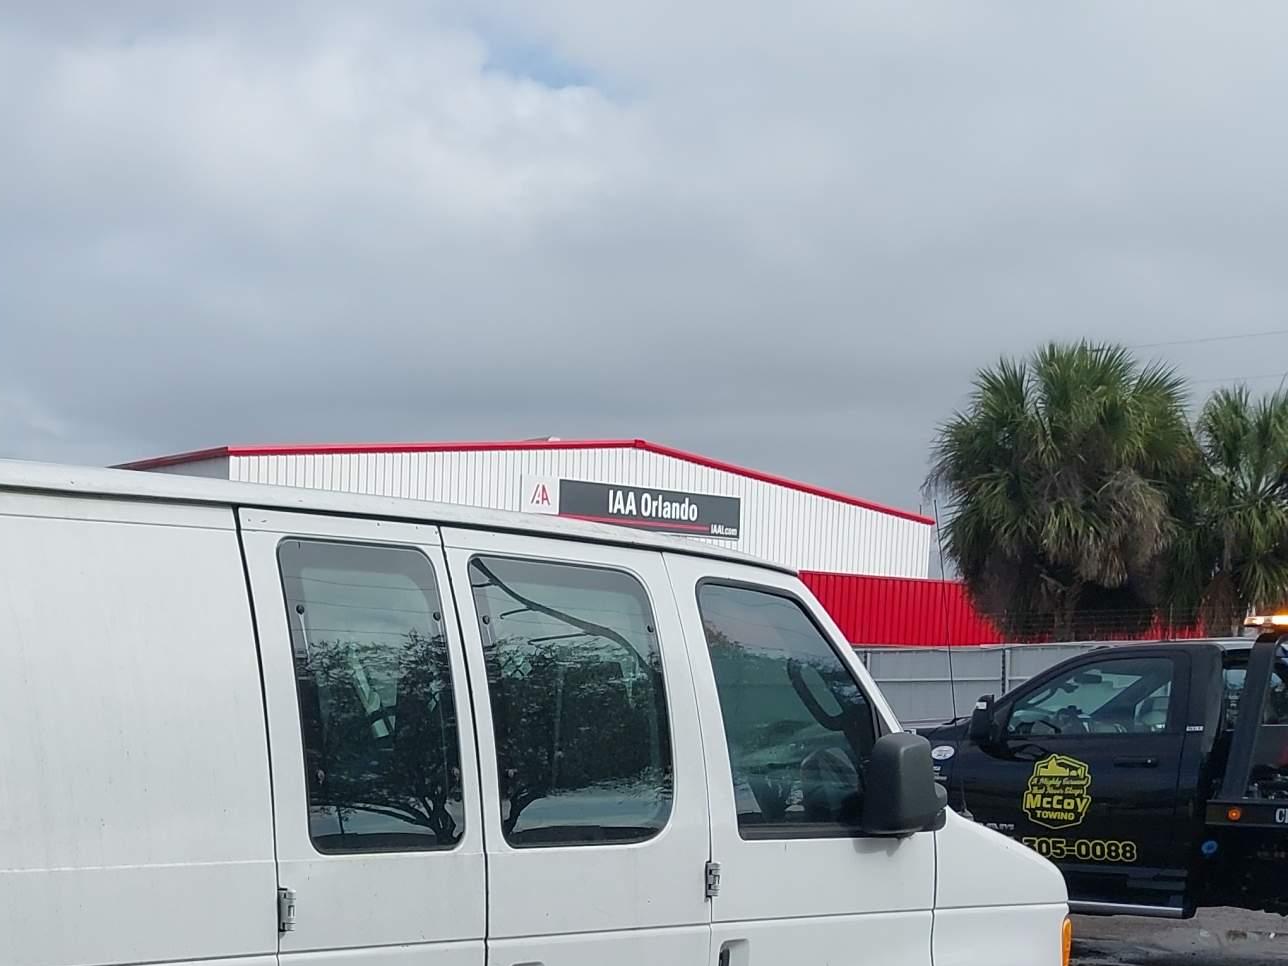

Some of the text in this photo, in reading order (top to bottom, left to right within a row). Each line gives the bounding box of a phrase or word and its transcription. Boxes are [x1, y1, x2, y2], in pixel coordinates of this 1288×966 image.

[607, 489, 698, 522] IAA Orlando
[1025, 793, 1088, 813] McCoy
[1035, 809, 1075, 821] TOWING
